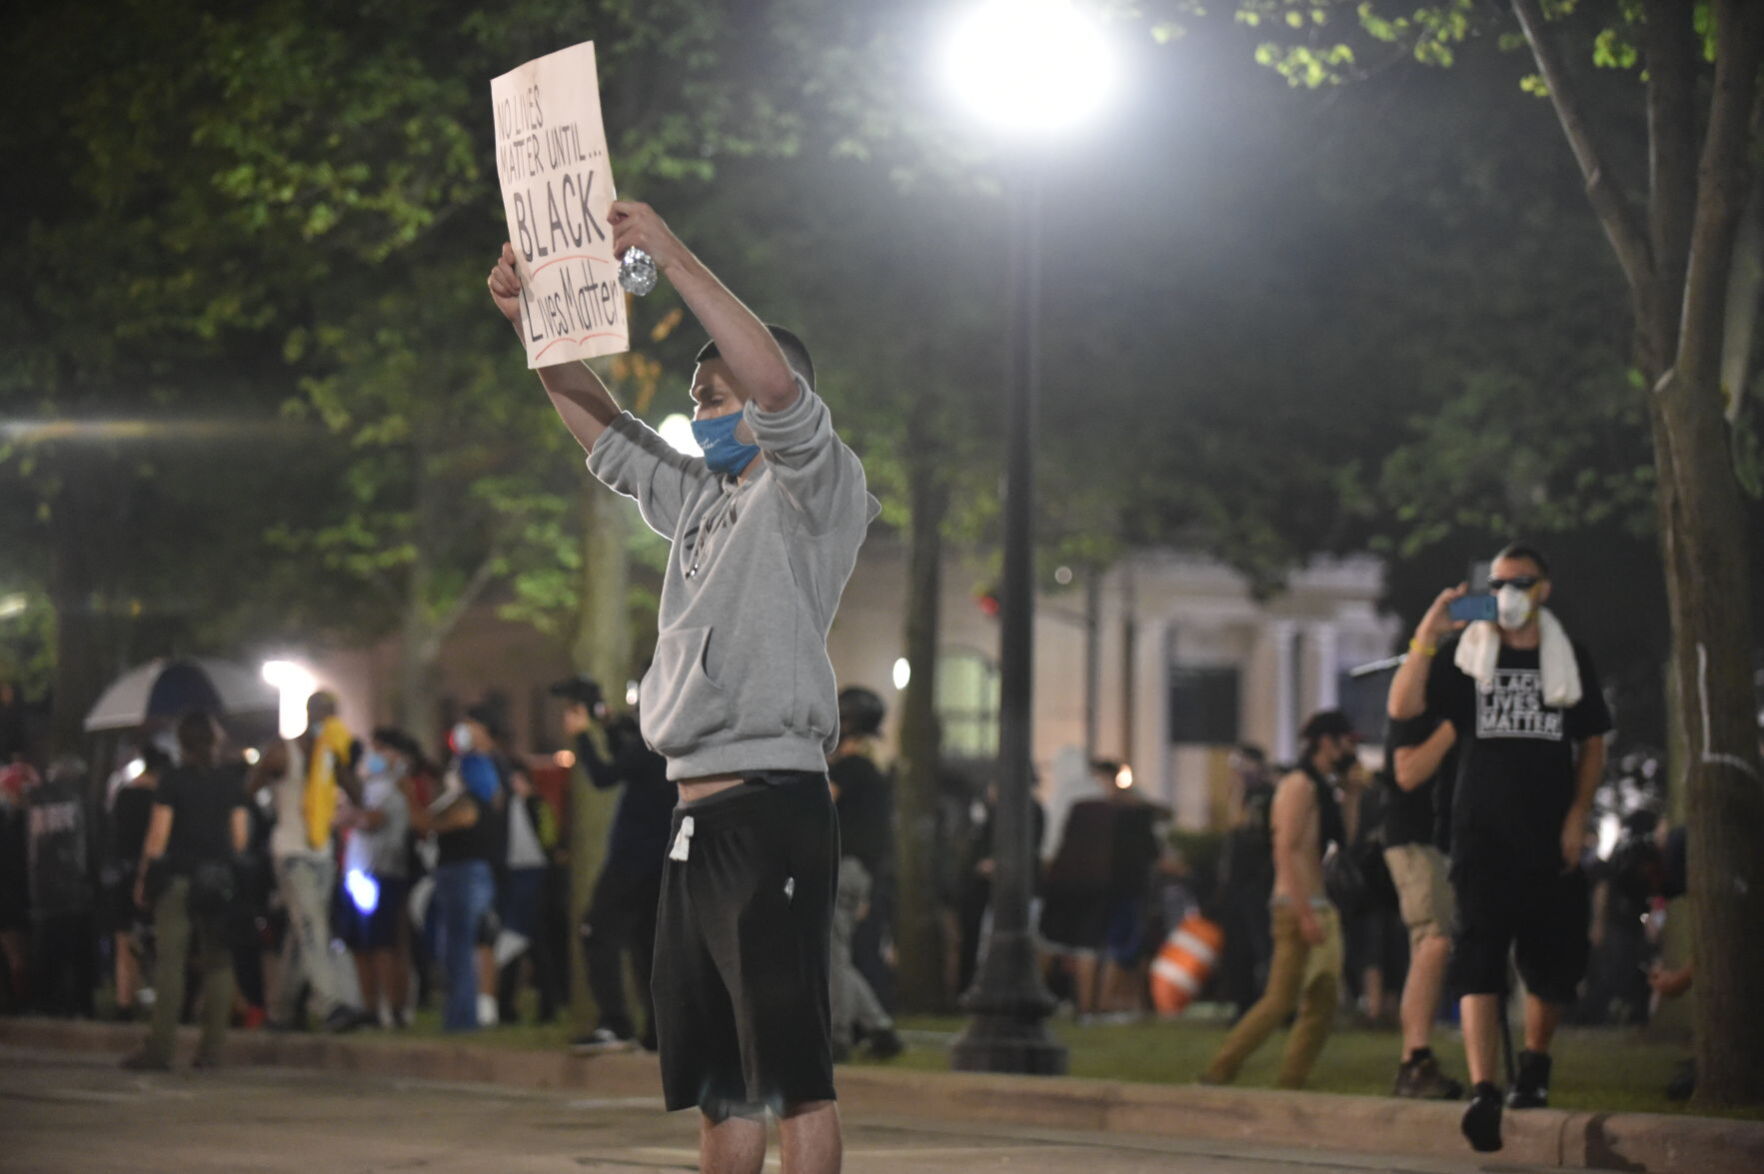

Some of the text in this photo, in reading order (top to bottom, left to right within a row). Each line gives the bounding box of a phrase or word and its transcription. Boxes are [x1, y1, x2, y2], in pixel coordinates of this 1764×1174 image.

[497, 84, 544, 141] NO LIVES
[500, 122, 602, 185] MATTER UNTIL...
[513, 170, 606, 263] BLACK
[519, 275, 569, 342] Lives
[1481, 693, 1540, 711] LIVES
[1481, 711, 1558, 733] MATTER
